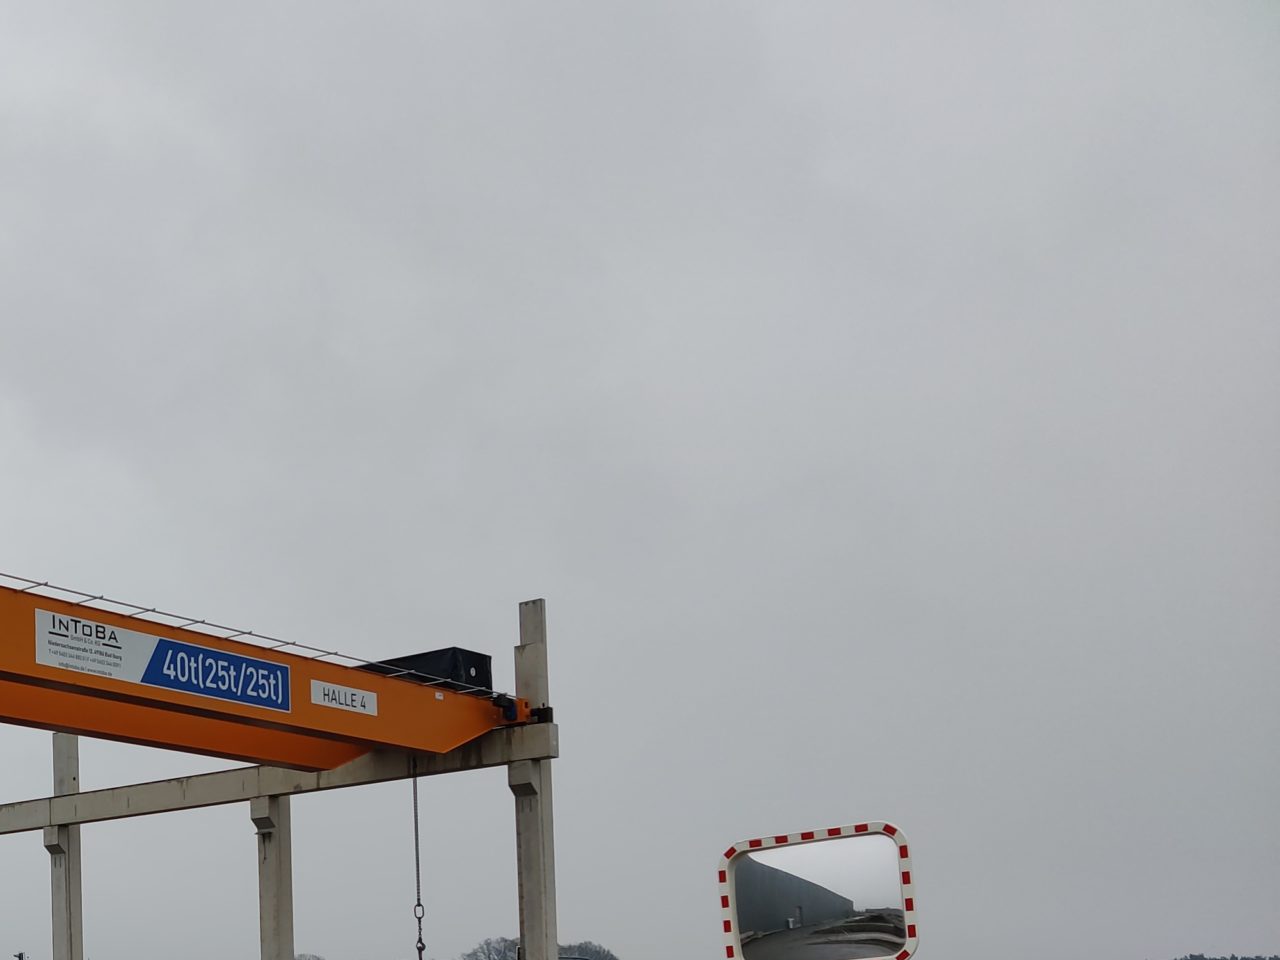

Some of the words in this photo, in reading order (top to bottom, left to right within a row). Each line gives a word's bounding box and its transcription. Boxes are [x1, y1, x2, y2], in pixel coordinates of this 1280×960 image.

[162, 649, 283, 704] 40t(25t/25t)
[322, 687, 357, 708] HALLE
[360, 695, 367, 710] 4
